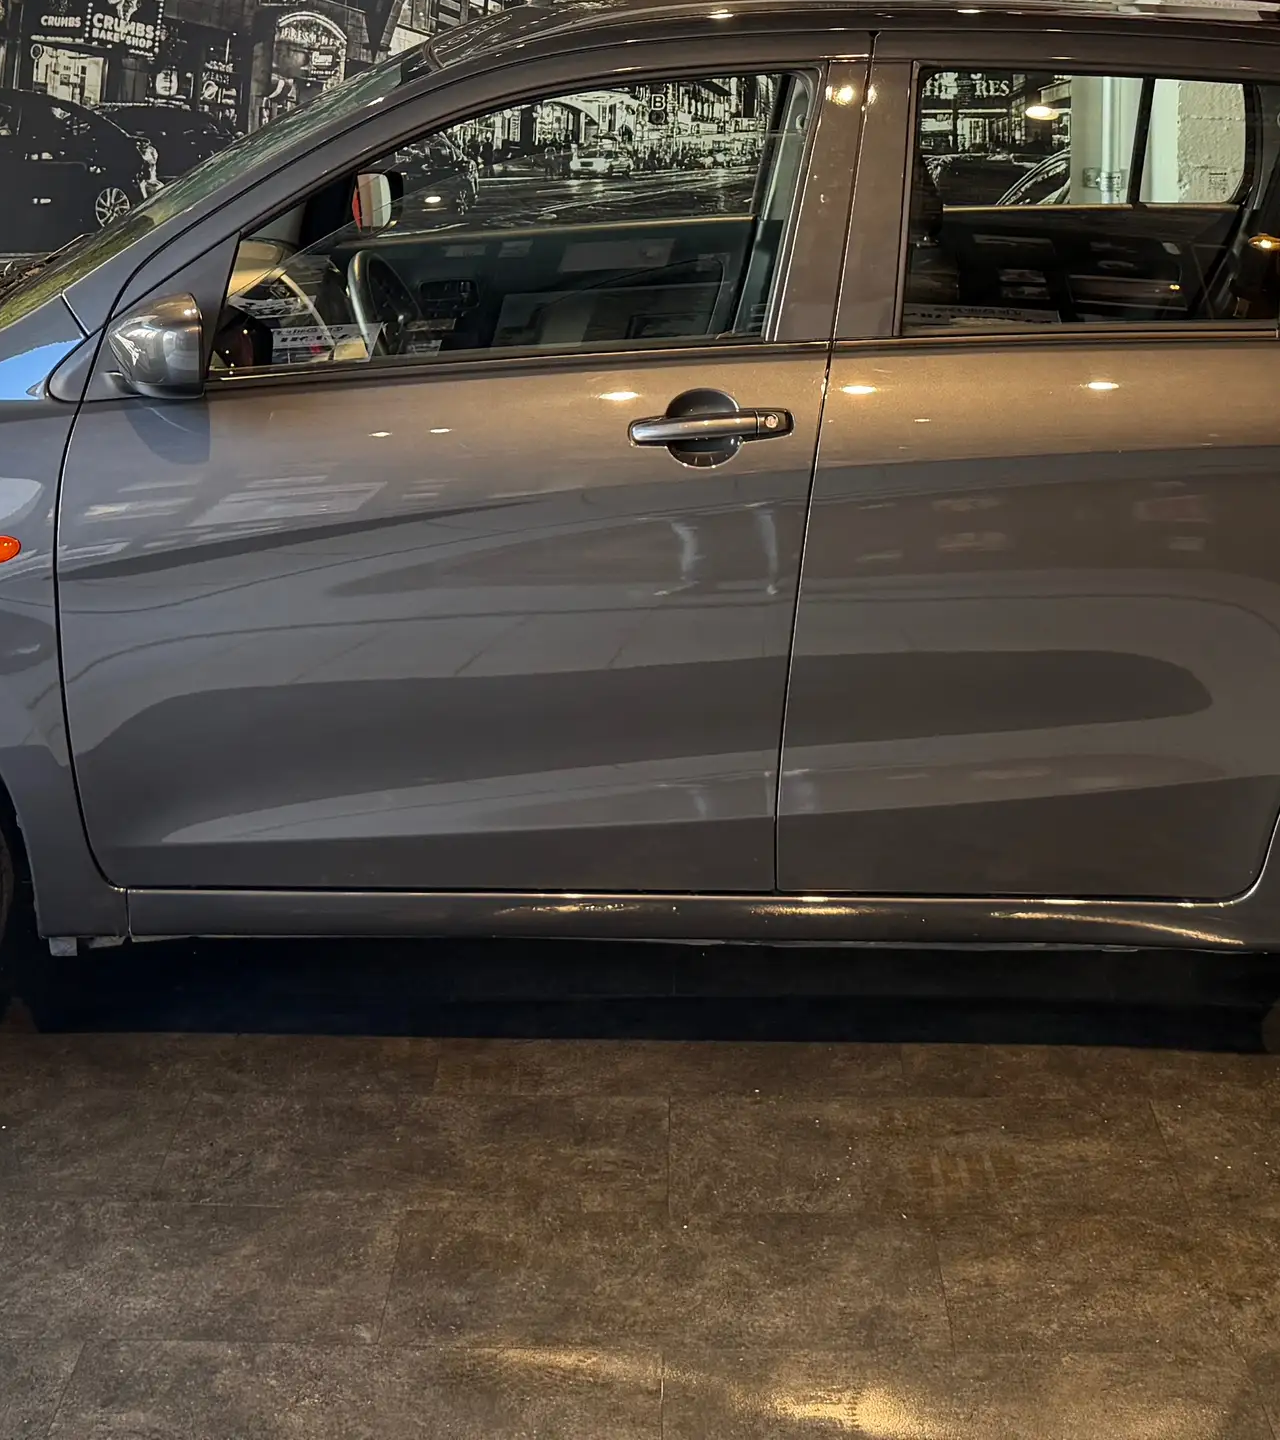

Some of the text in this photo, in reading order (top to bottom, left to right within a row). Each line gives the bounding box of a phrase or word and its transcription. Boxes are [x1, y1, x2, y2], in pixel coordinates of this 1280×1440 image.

[40, 14, 81, 28] CRUMBS
[92, 13, 155, 39] CRUMBS
[92, 28, 153, 48] BAKE SHOP
